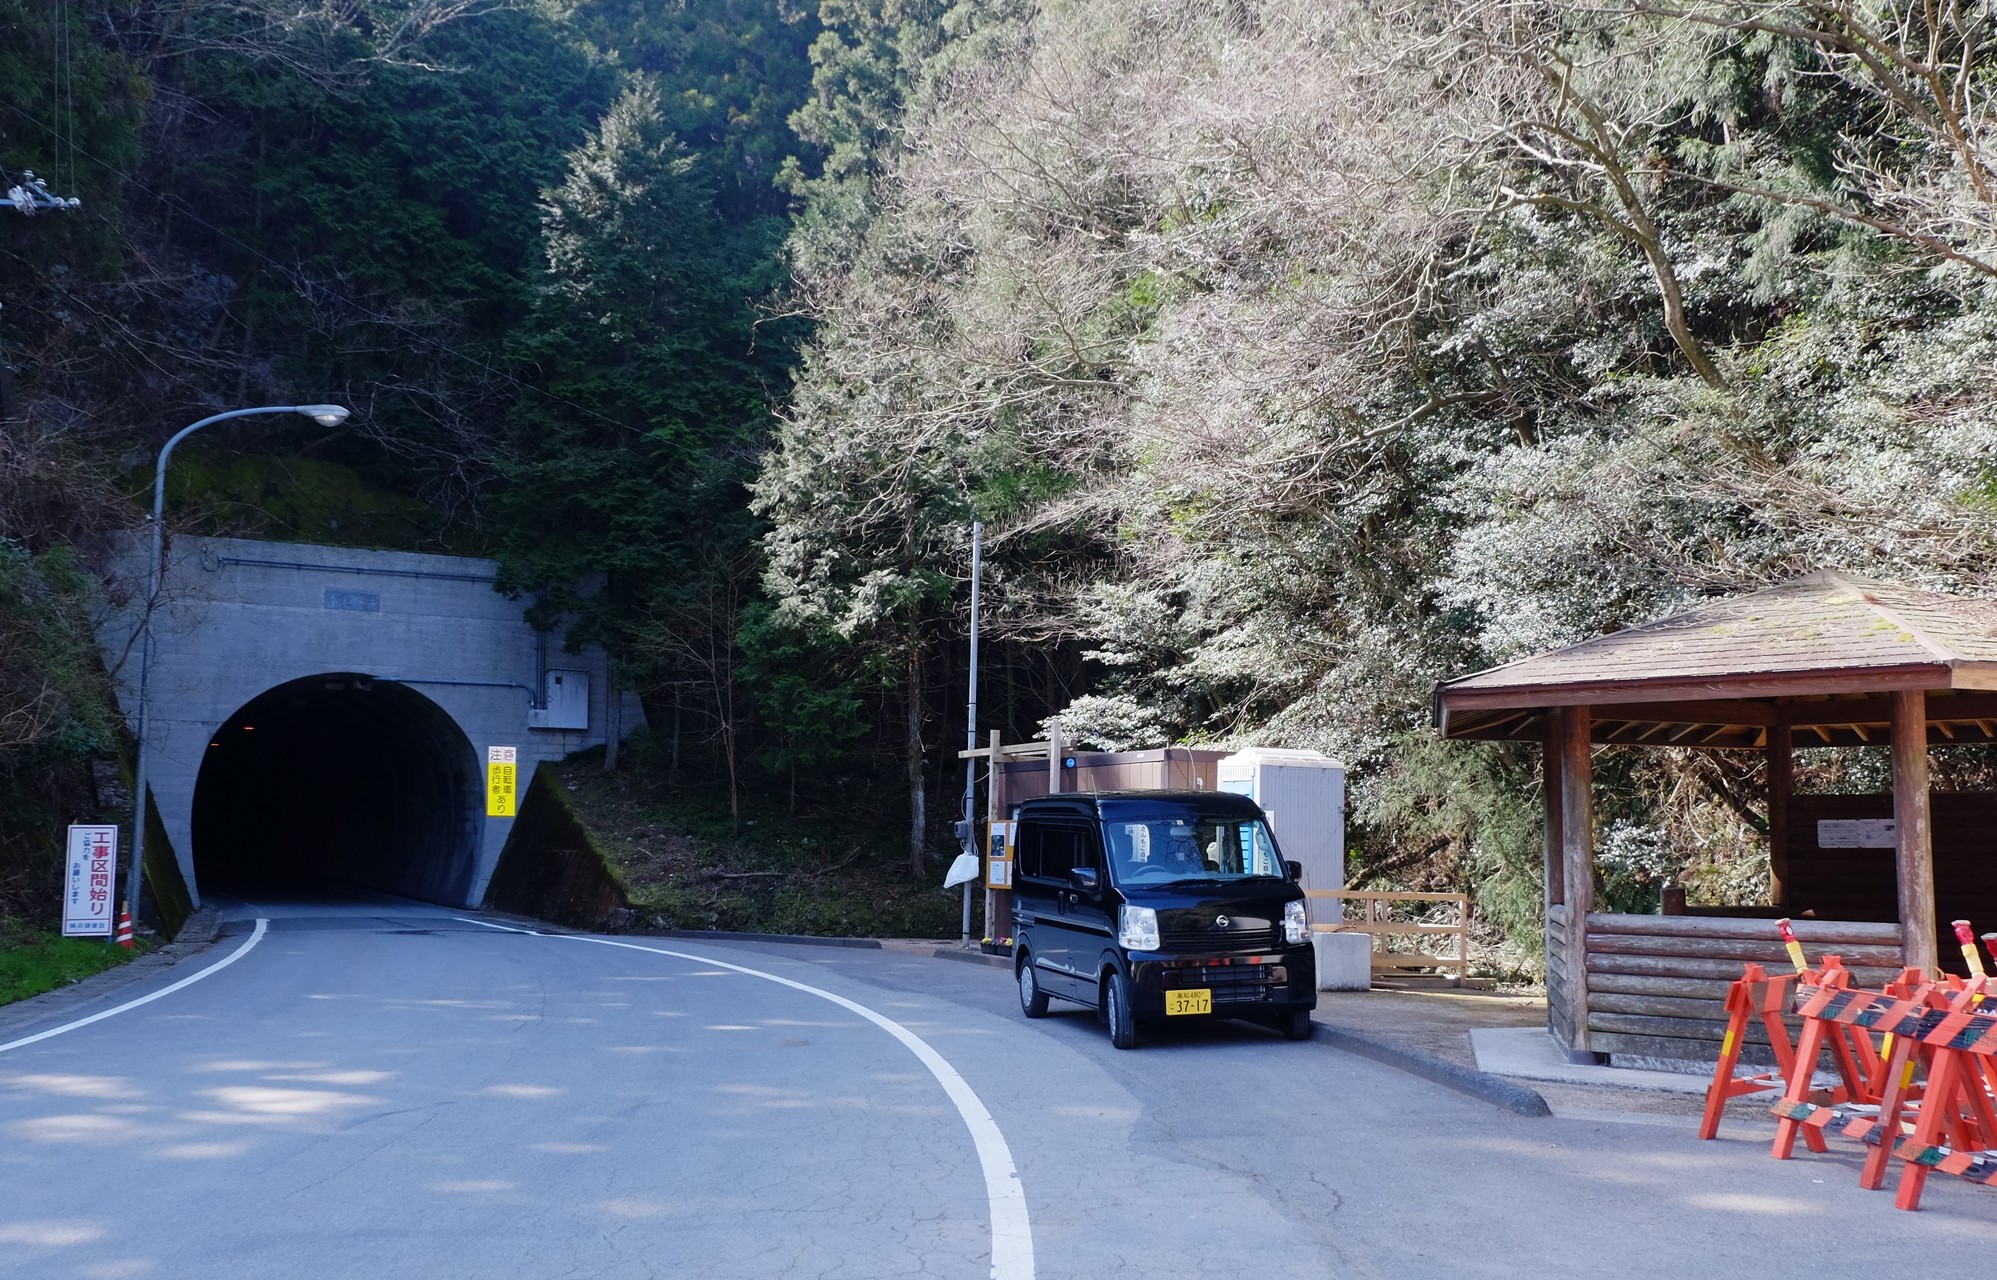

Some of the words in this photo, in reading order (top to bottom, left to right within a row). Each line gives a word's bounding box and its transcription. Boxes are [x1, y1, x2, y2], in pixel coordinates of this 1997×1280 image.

[490, 749, 514, 761] 注意
[491, 765, 501, 794] 歩行者
[503, 766, 512, 794] 自転車
[497, 795, 506, 814] あり
[82, 832, 91, 860] ご協力を
[71, 862, 80, 904] お願いします
[89, 831, 110, 915] 工事区間始り
[1176, 999, 1209, 1013] 37-17
